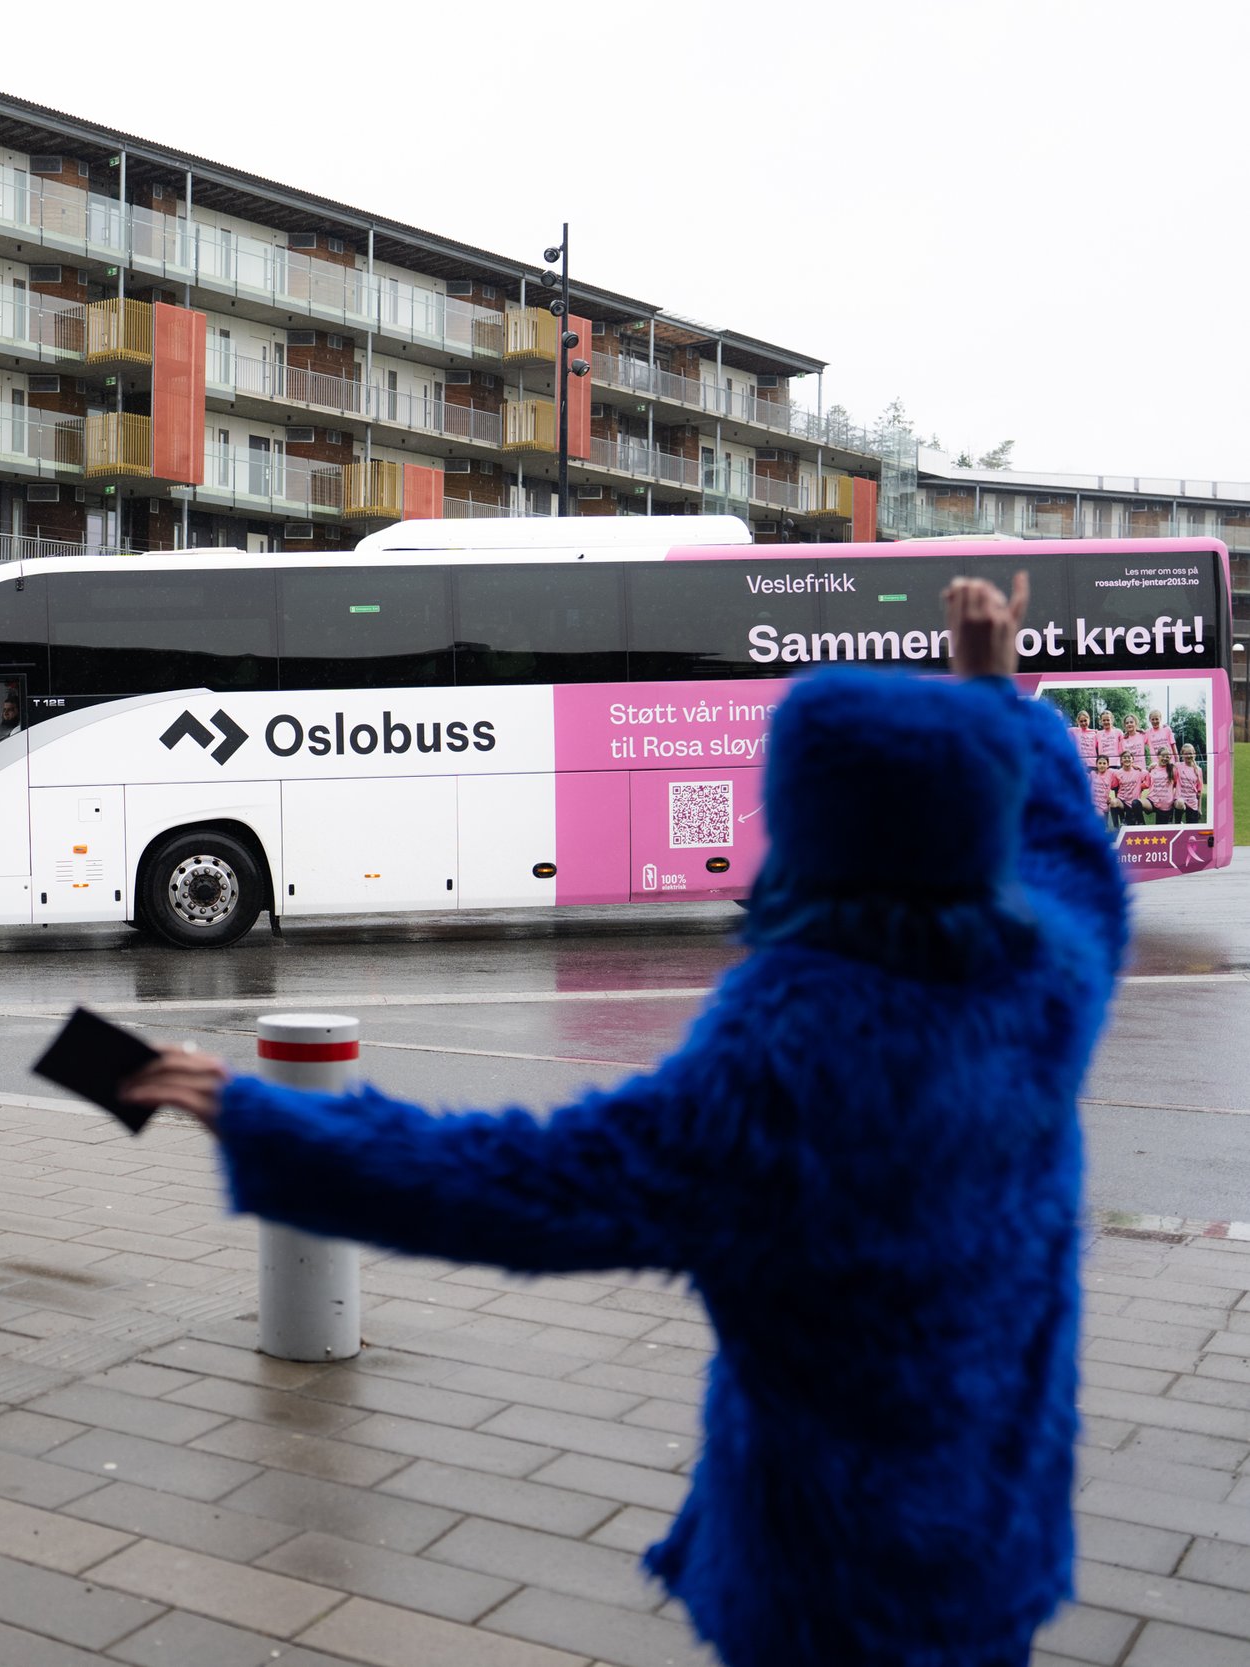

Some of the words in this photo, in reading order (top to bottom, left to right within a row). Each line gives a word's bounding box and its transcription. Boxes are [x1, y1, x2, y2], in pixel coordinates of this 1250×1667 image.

[1125, 568, 1139, 576] Les
[1172, 567, 1187, 575] oss
[1187, 566, 1199, 576] på
[746, 573, 856, 594] Veslefrikk
[1095, 577, 1200, 588] rosasløyfe-jenter2013.no
[748, 624, 954, 663] Sammen
[1015, 620, 1065, 657] ot
[1076, 615, 1205, 656] kreft!
[33, 699, 40, 707] T
[42, 698, 66, 707] 12E
[609, 703, 677, 725] Støtt
[682, 700, 722, 723] vår
[728, 700, 778, 722] inns
[264, 710, 496, 757] Oslobuss
[610, 736, 637, 758] til
[643, 736, 704, 758] Rosa
[709, 733, 770, 760] sløyf
[1145, 851, 1168, 863] 2013
[661, 874, 687, 884] 100%
